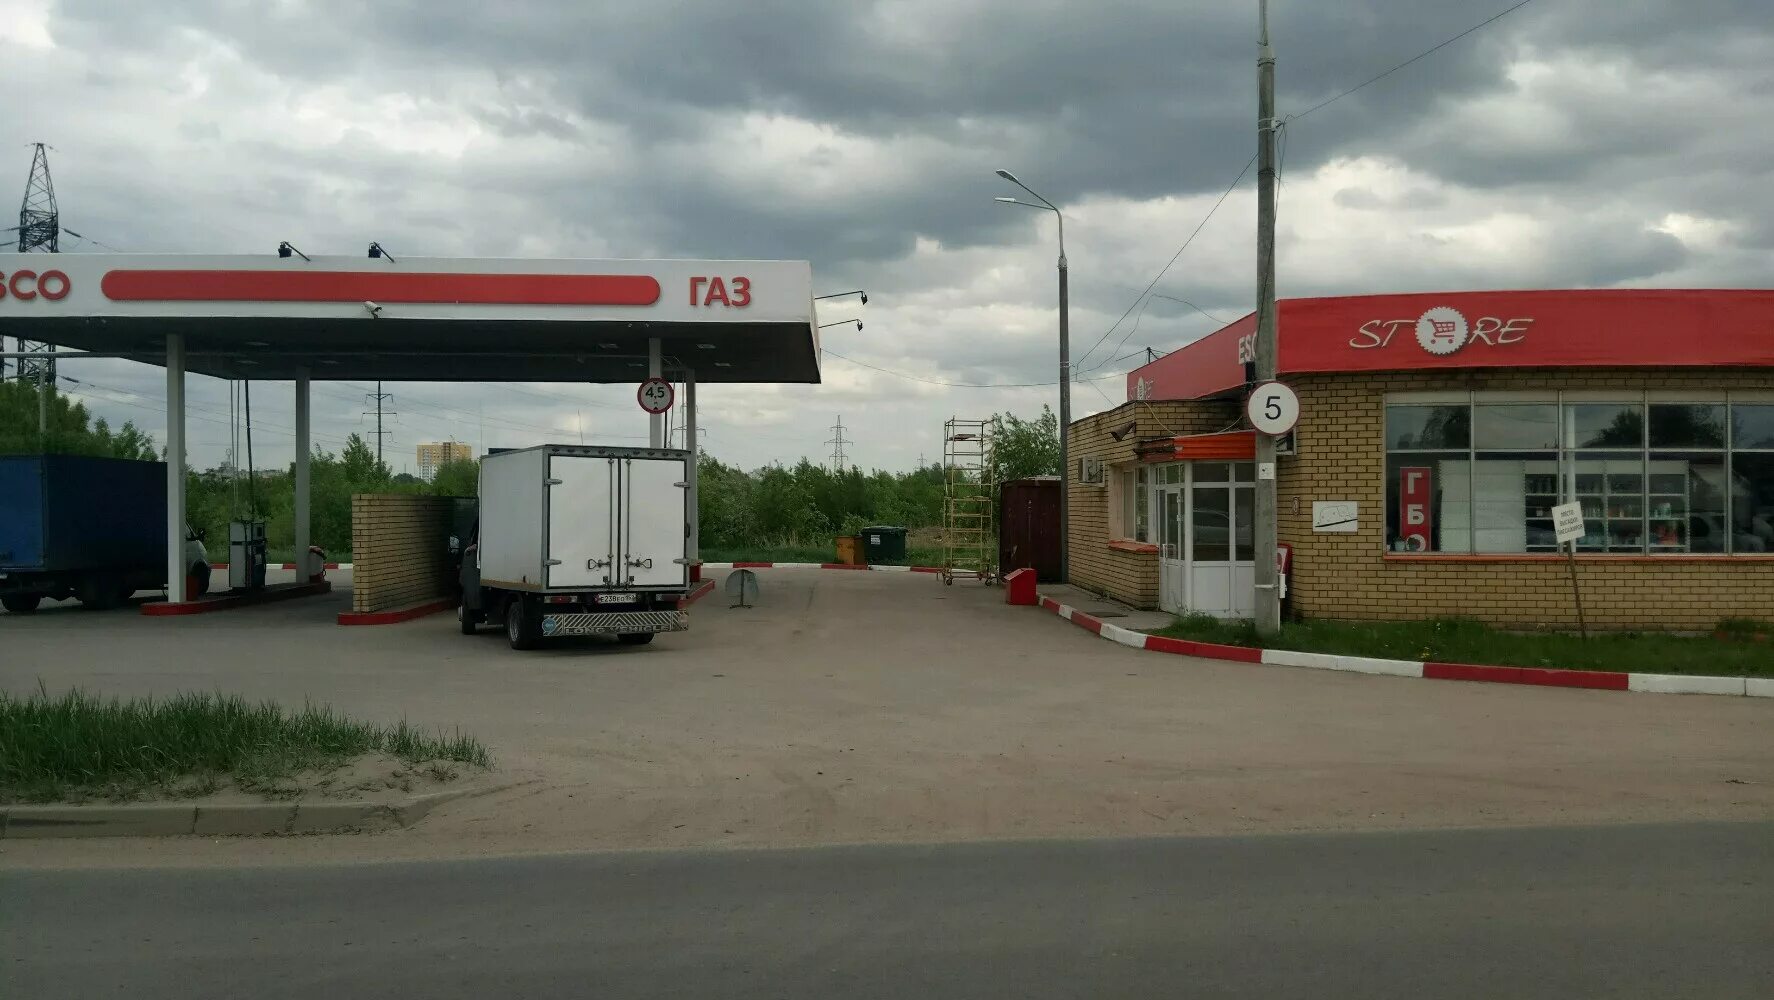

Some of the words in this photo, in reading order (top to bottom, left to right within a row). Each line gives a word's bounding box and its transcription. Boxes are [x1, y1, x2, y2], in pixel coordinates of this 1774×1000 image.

[689, 276, 751, 307] ГАЗ
[645, 386, 665, 399] 4,5
[1264, 395, 1282, 420] 5
[1405, 471, 1427, 552] ГБО
[609, 624, 670, 633] VEHICLE
